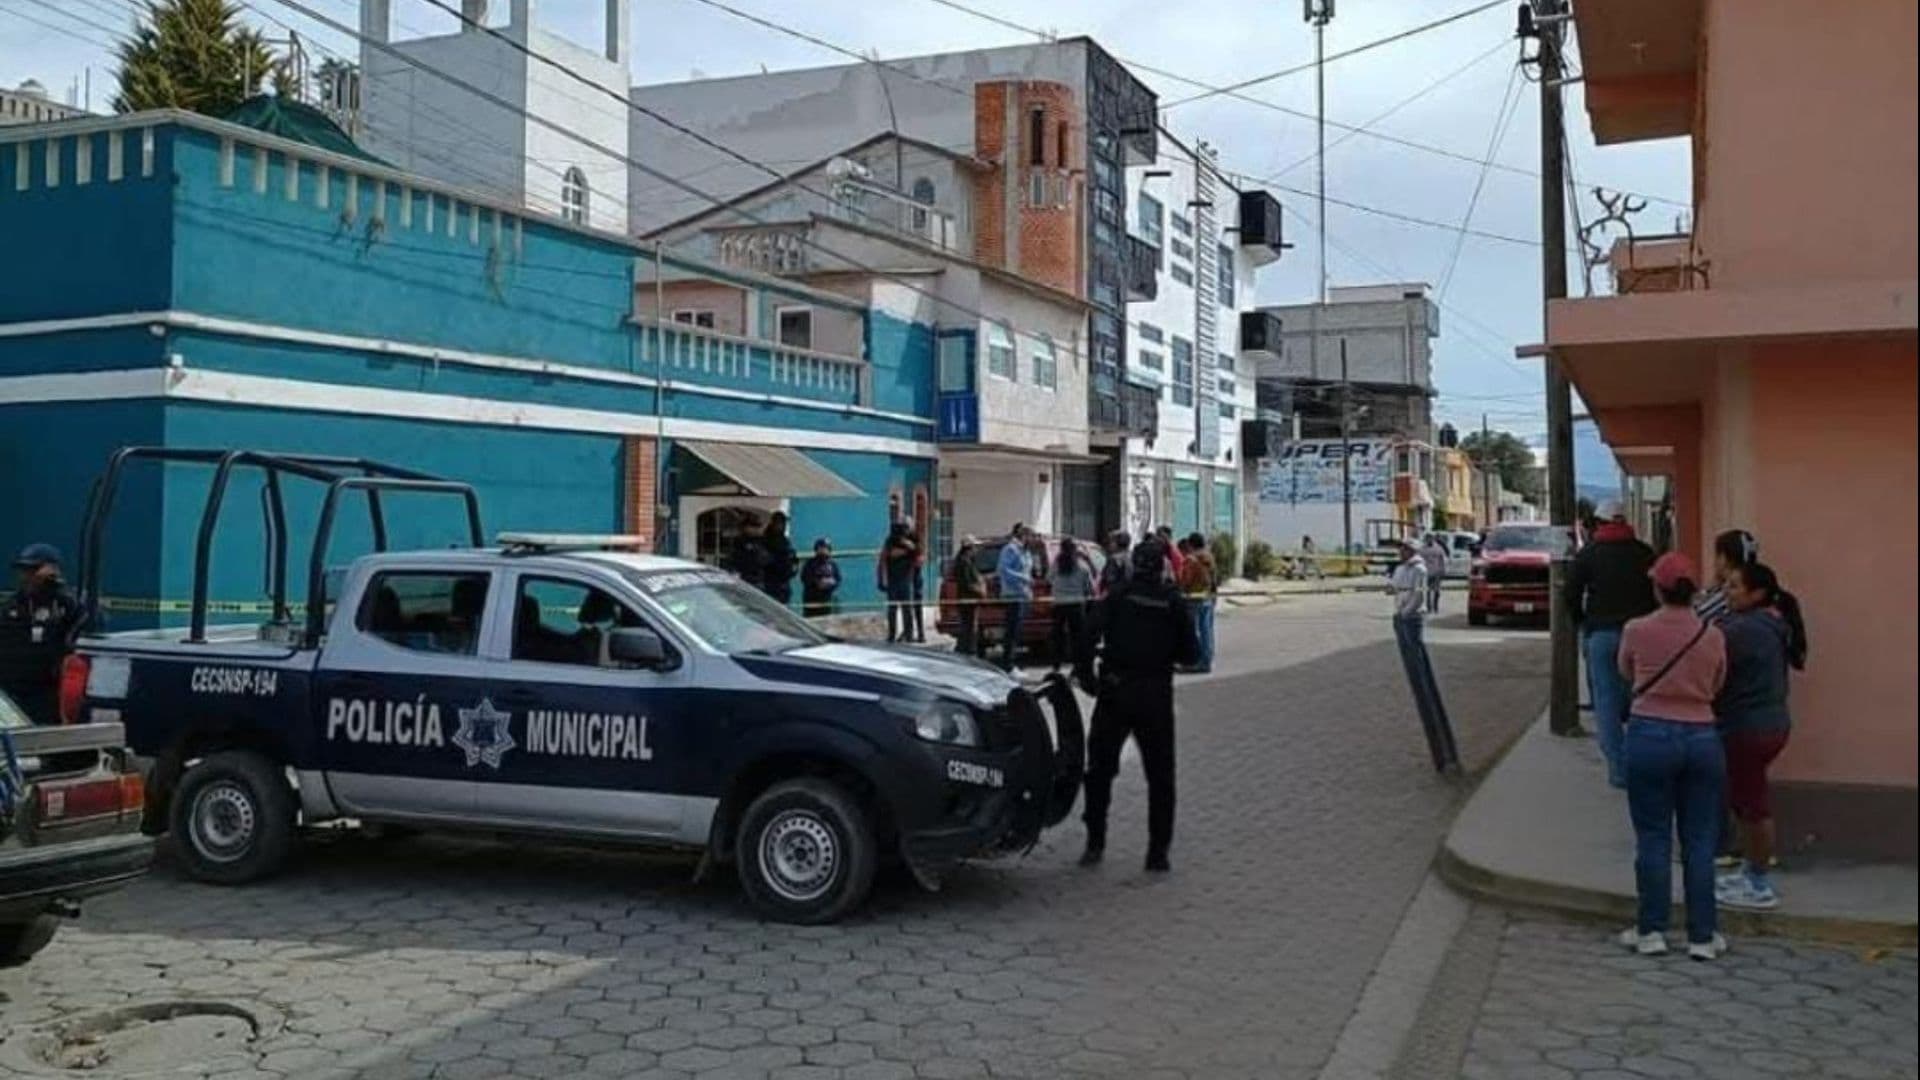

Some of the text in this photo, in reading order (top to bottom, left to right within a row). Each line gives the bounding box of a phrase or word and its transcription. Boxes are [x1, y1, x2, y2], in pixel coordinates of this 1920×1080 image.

[191, 665, 278, 695] CECSNSP-194
[327, 693, 653, 761] POLICÍA MUNICIPAL
